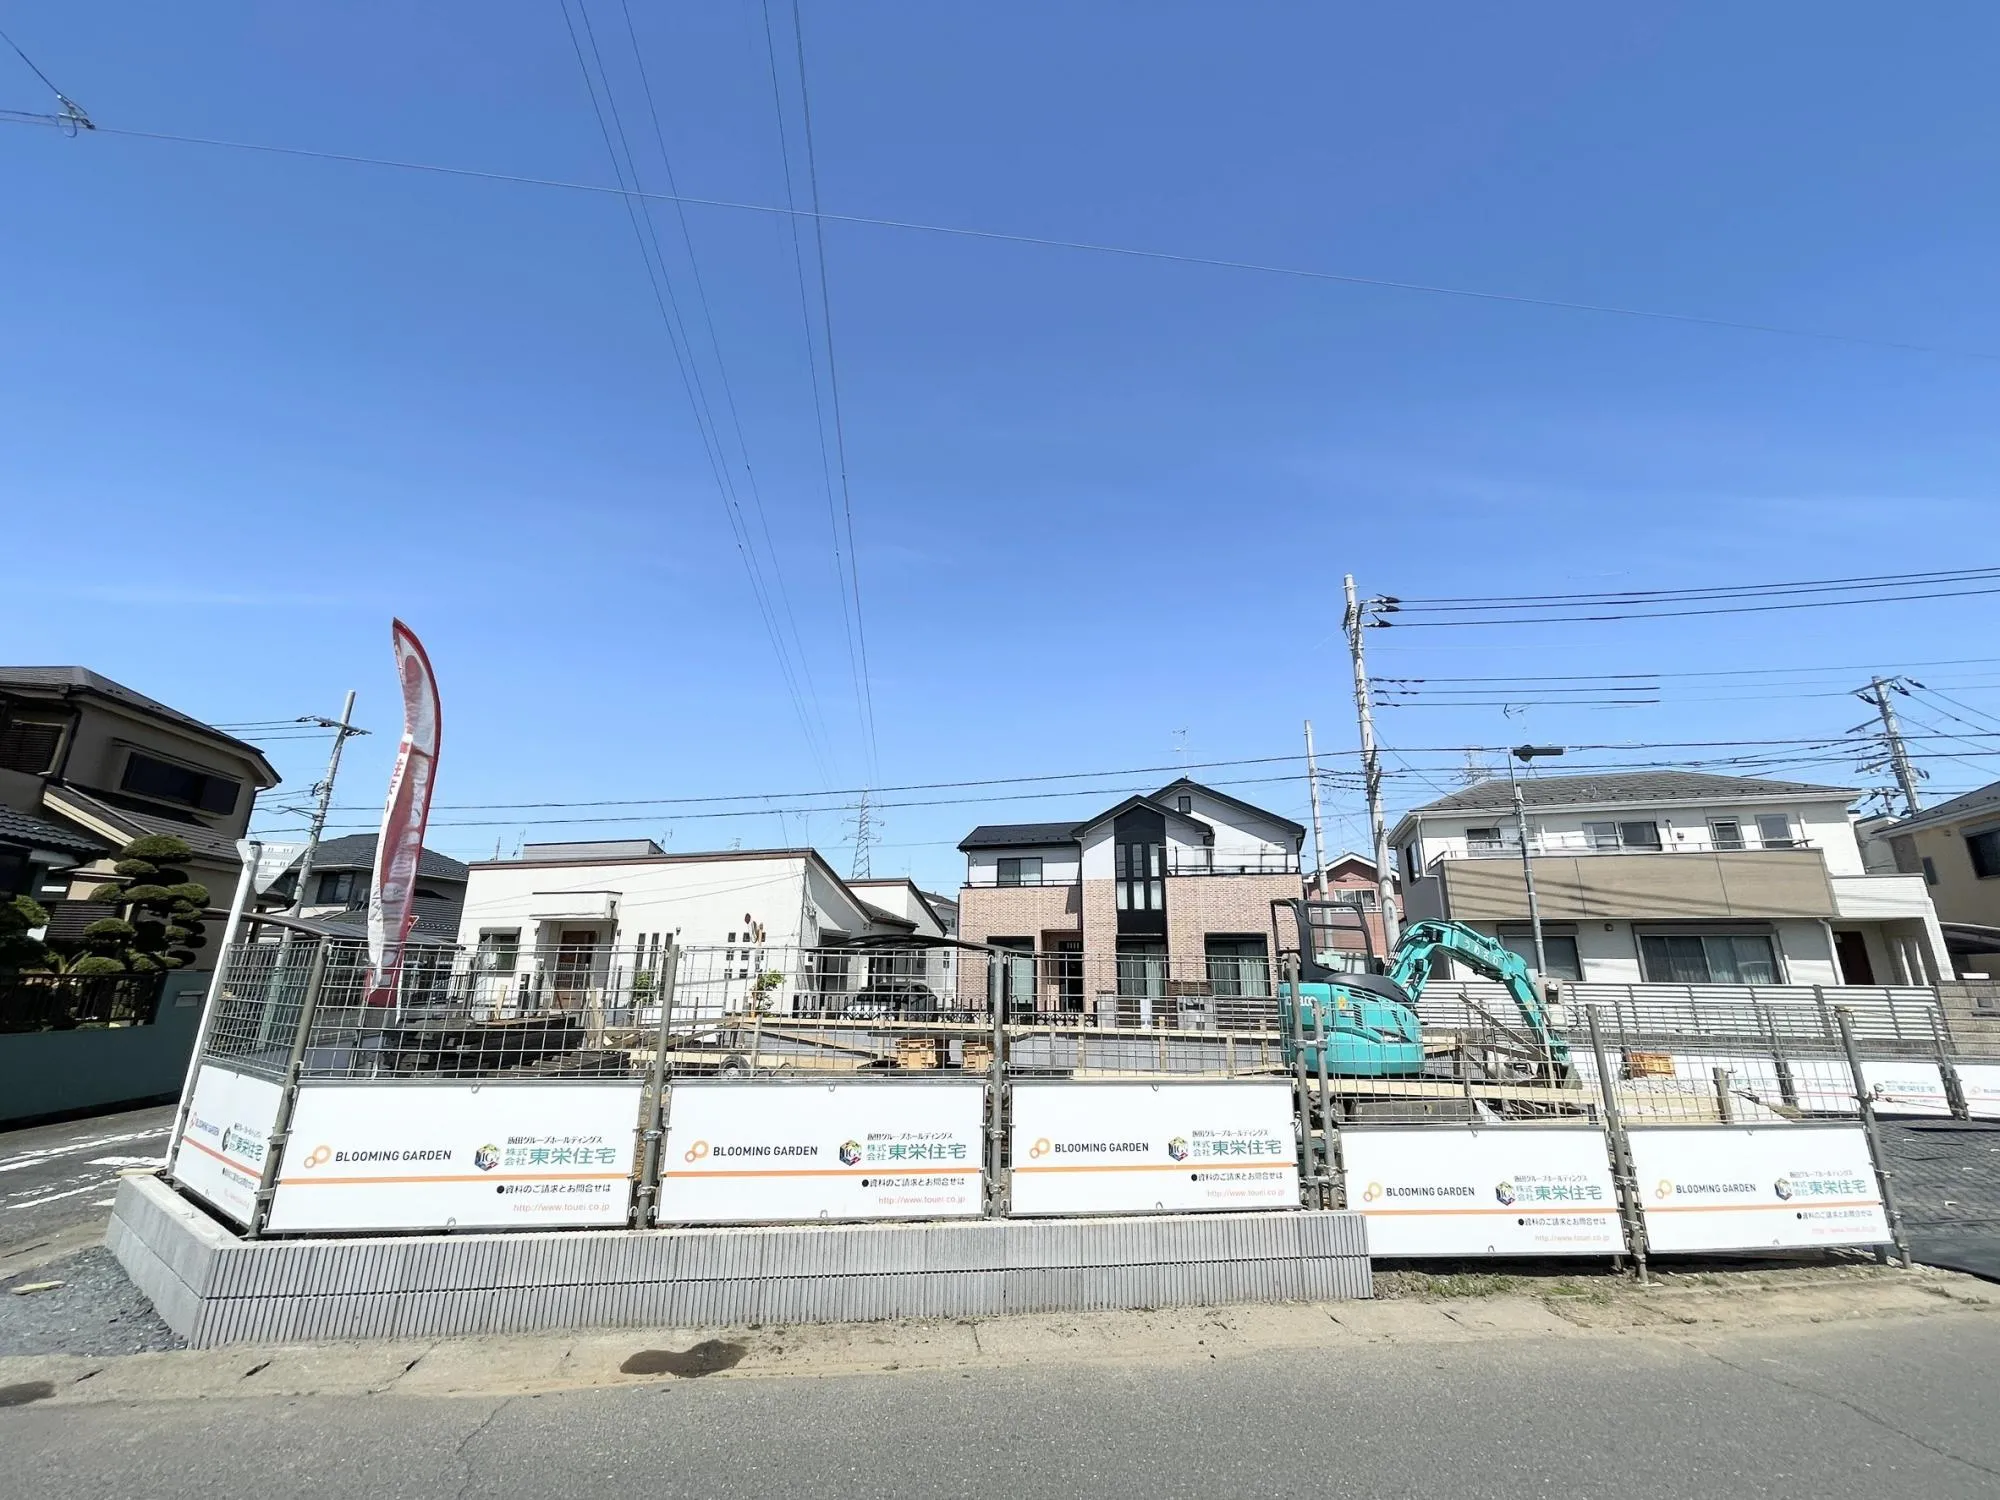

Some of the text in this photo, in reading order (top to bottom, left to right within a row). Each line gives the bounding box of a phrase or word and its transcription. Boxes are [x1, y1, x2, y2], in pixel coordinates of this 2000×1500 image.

[713, 1146, 818, 1156] BLOOMING GARDEN
[888, 1143, 966, 1160] 東栄住宅
[1055, 1143, 1148, 1153] BLOOMING GARDEN
[1212, 1139, 1281, 1155] 東栄住宅
[335, 1150, 451, 1161] BLOOMING GARDEN
[528, 1147, 616, 1165] 東栄住宅
[1386, 1187, 1475, 1196] BLOOMING GARDEN
[1535, 1185, 1602, 1200] 東栄住宅
[1676, 1184, 1756, 1193] BLOOMING GARDEN
[1809, 1180, 1866, 1195] 東栄住宅
